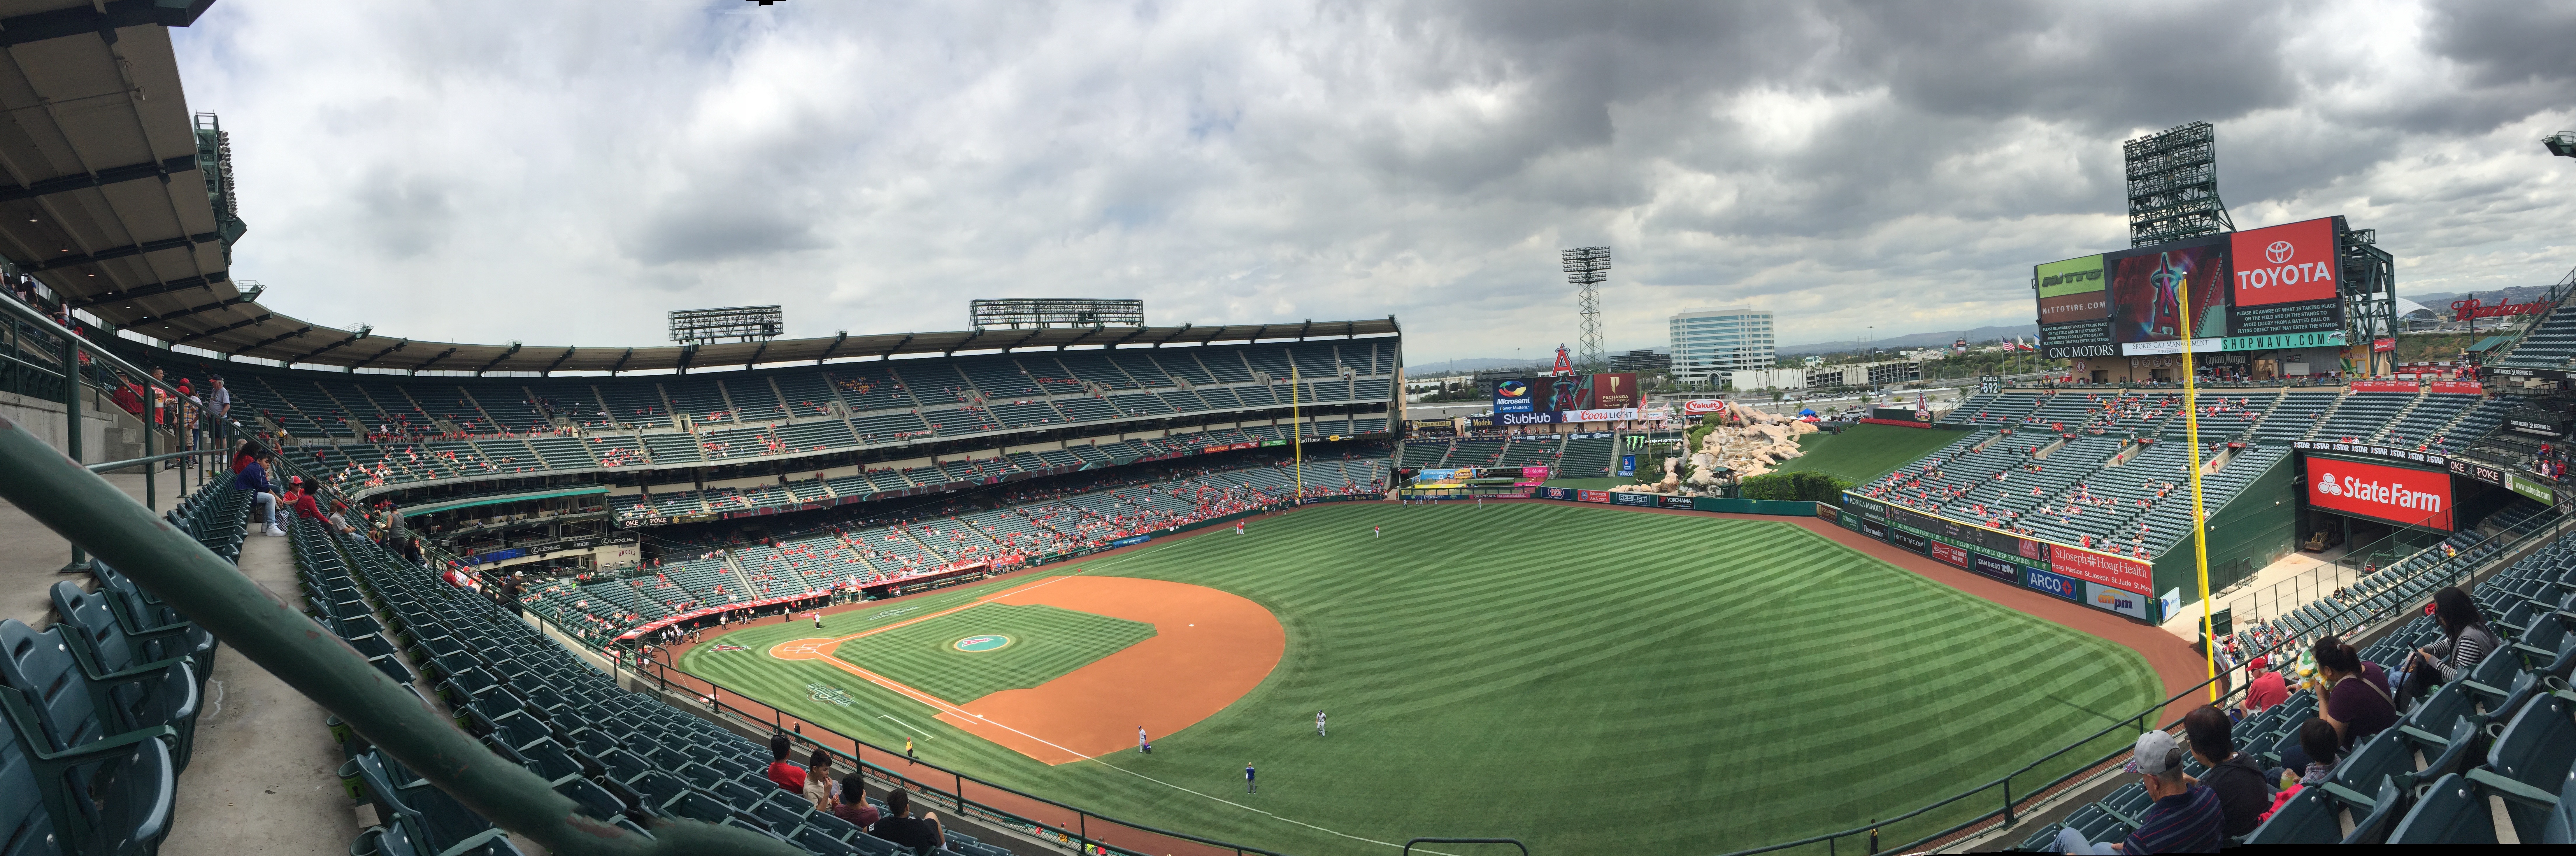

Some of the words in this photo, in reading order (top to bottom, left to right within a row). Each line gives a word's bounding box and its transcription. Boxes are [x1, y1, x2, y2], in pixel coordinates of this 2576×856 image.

[2238, 261, 2331, 289] TOYOTA
[2042, 301, 2105, 314] NITTOTIRE.COM
[2223, 334, 2325, 351] SHOPWAVY.COM
[2050, 347, 2070, 358] CNC
[2072, 344, 2114, 357] MOTORS
[2205, 354, 2224, 366] Captain
[2224, 352, 2246, 365] Morgan
[1983, 383, 1998, 393] 592
[1504, 413, 1551, 424] StubHub
[1581, 410, 1608, 420] Coors
[2451, 461, 2464, 472] OKE
[2477, 467, 2499, 480] POKE
[2344, 476, 2389, 504] State
[2391, 483, 2440, 513] Farm
[2515, 482, 2550, 501] www.usfoods.com
[1822, 507, 1836, 516] PECHANGA
[1850, 497, 1865, 508] KONICA
[1866, 502, 1884, 513] MINOLTA
[1865, 512, 1884, 522] reshapework.com
[1863, 525, 1884, 537] Thermador
[1904, 525, 1919, 534] DOMINION
[1920, 530, 1933, 538] FREIGHT
[1896, 533, 1906, 542] NITTO
[1907, 538, 1924, 548] TIRE.COM
[1957, 541, 1973, 549] HELPING
[1981, 548, 1995, 556] WORLD
[2008, 555, 2030, 565] PROMISES
[1988, 561, 2001, 570] DIEGO
[2052, 562, 2064, 571] Hoag
[2066, 566, 2083, 576] Mission
[2096, 557, 2118, 575] Hoag
[2119, 561, 2147, 578] Health
[2031, 572, 2061, 592] ARCO
[2098, 594, 2133, 610] ampm
[808, 683, 834, 697] OPENING
[832, 695, 855, 706] WEEK
